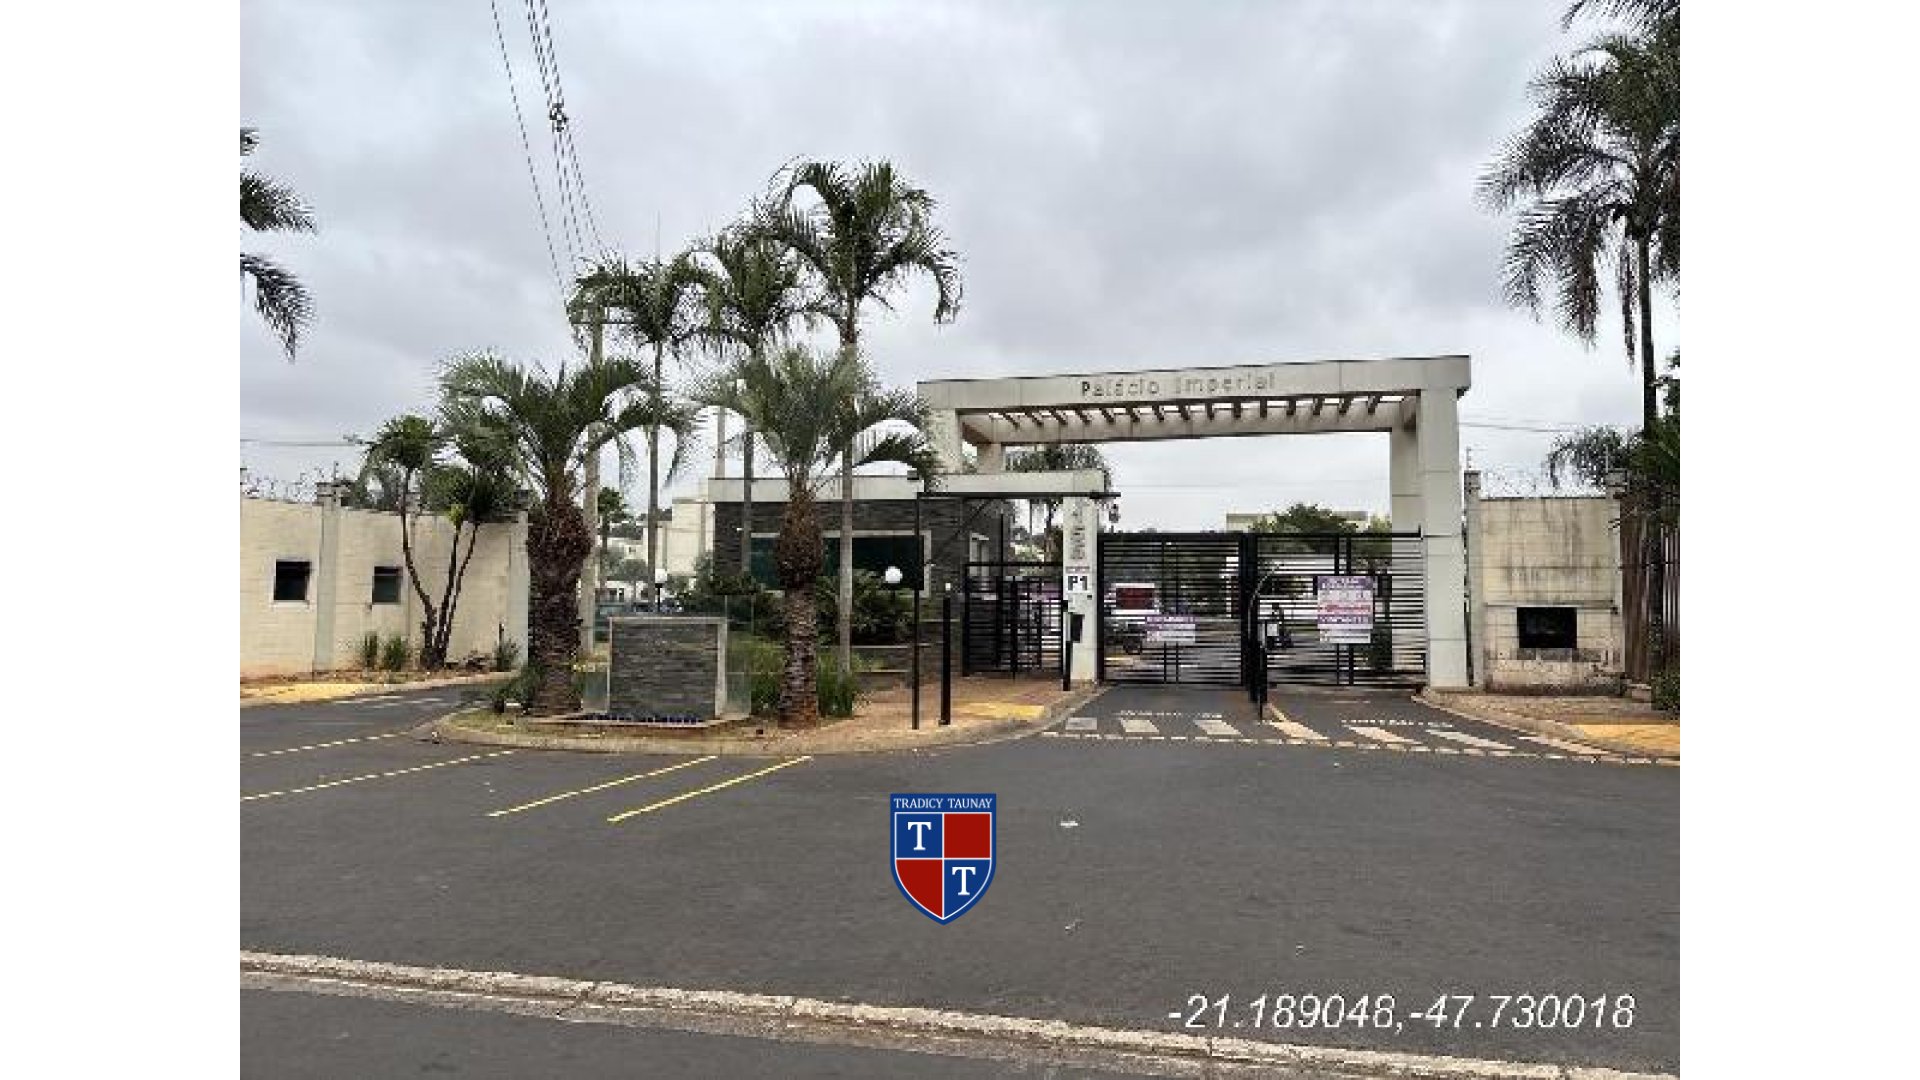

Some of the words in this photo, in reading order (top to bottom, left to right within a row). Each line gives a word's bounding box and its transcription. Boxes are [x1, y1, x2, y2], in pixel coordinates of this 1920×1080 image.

[1081, 378, 1159, 397] Palácio
[1175, 371, 1276, 394] Imperial
[1067, 575, 1088, 591] P1
